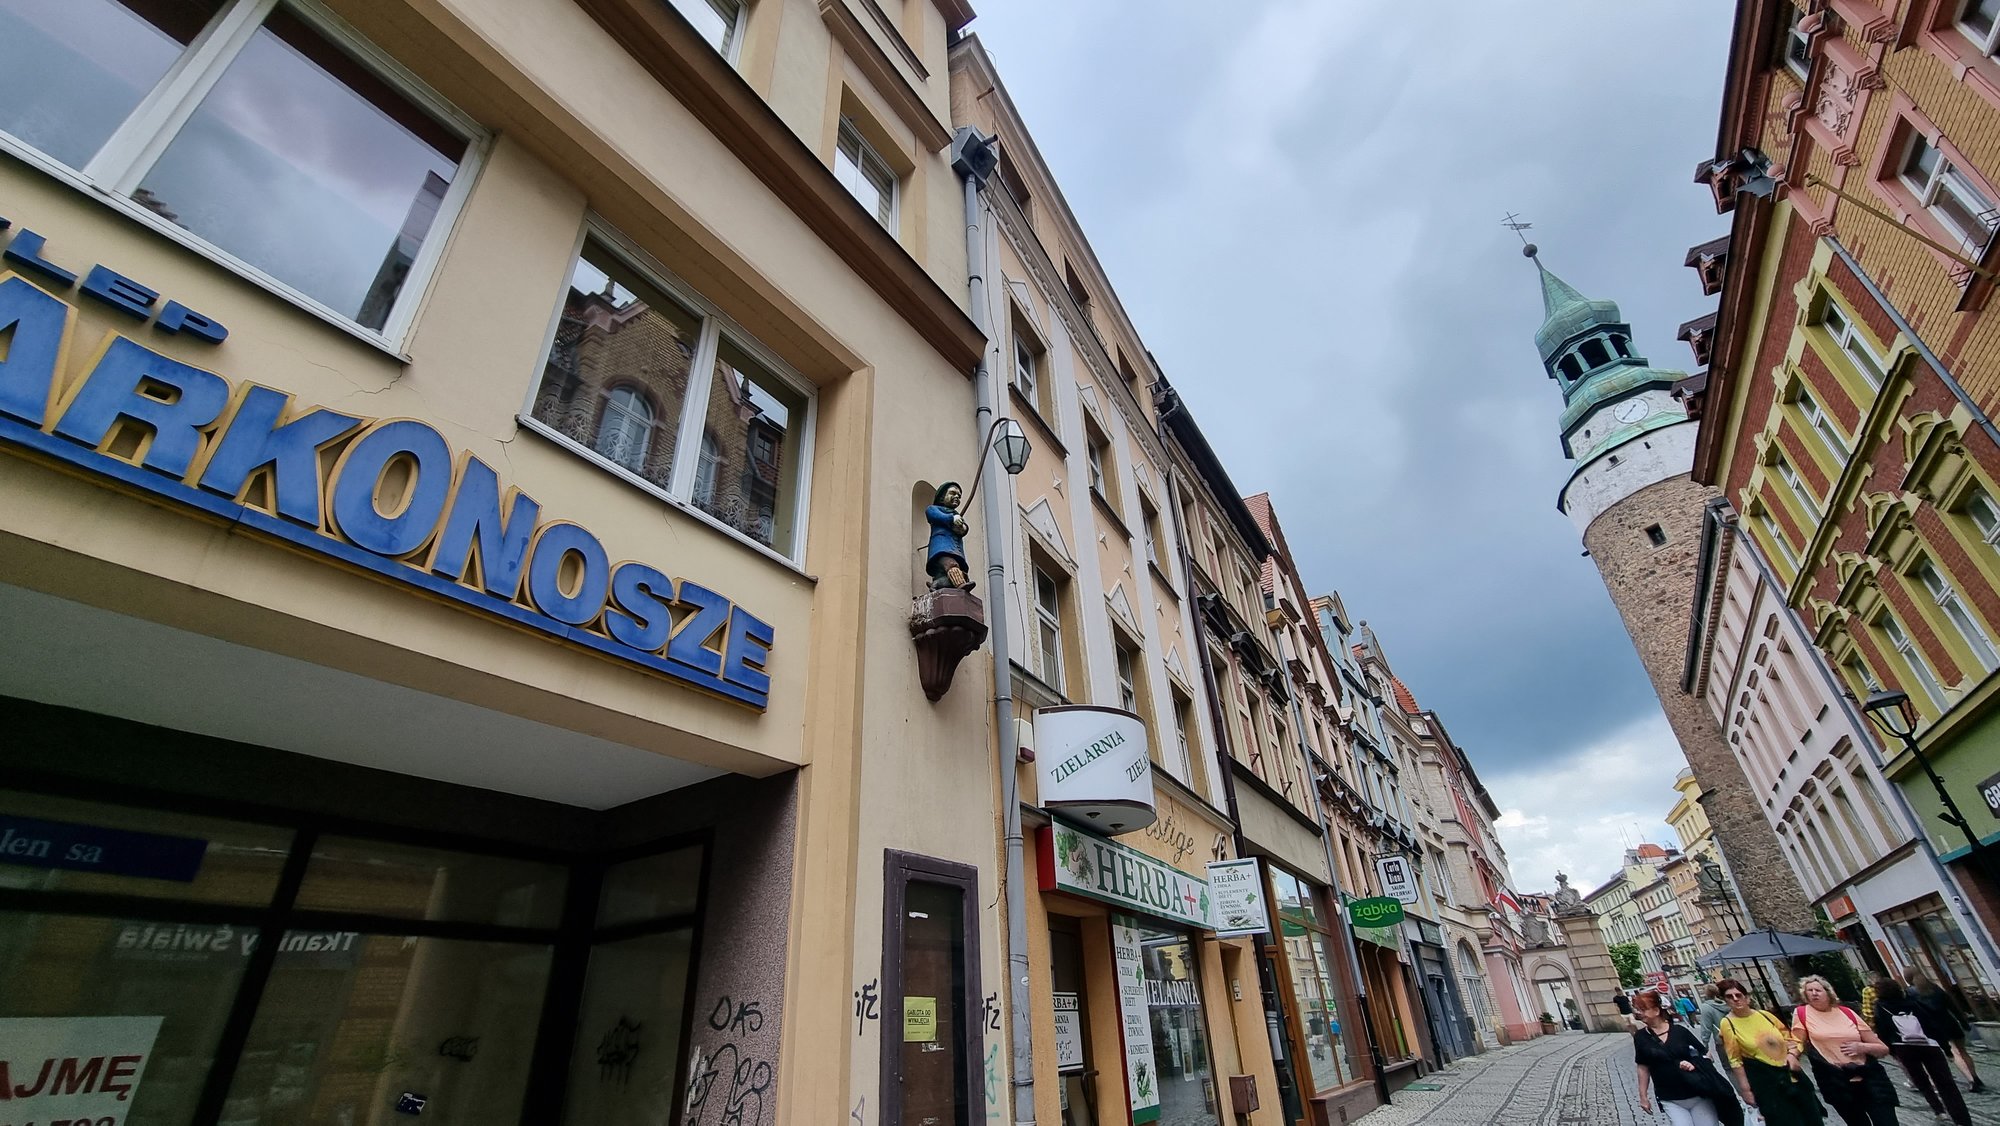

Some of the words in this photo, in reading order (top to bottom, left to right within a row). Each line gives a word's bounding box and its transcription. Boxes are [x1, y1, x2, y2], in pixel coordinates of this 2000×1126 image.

[0, 216, 229, 344] LEP
[1050, 730, 1126, 784] ZIELARNIA
[64, 841, 104, 864] sa
[1355, 903, 1398, 917] żabka
[1145, 979, 1201, 1006] IELARNIA
